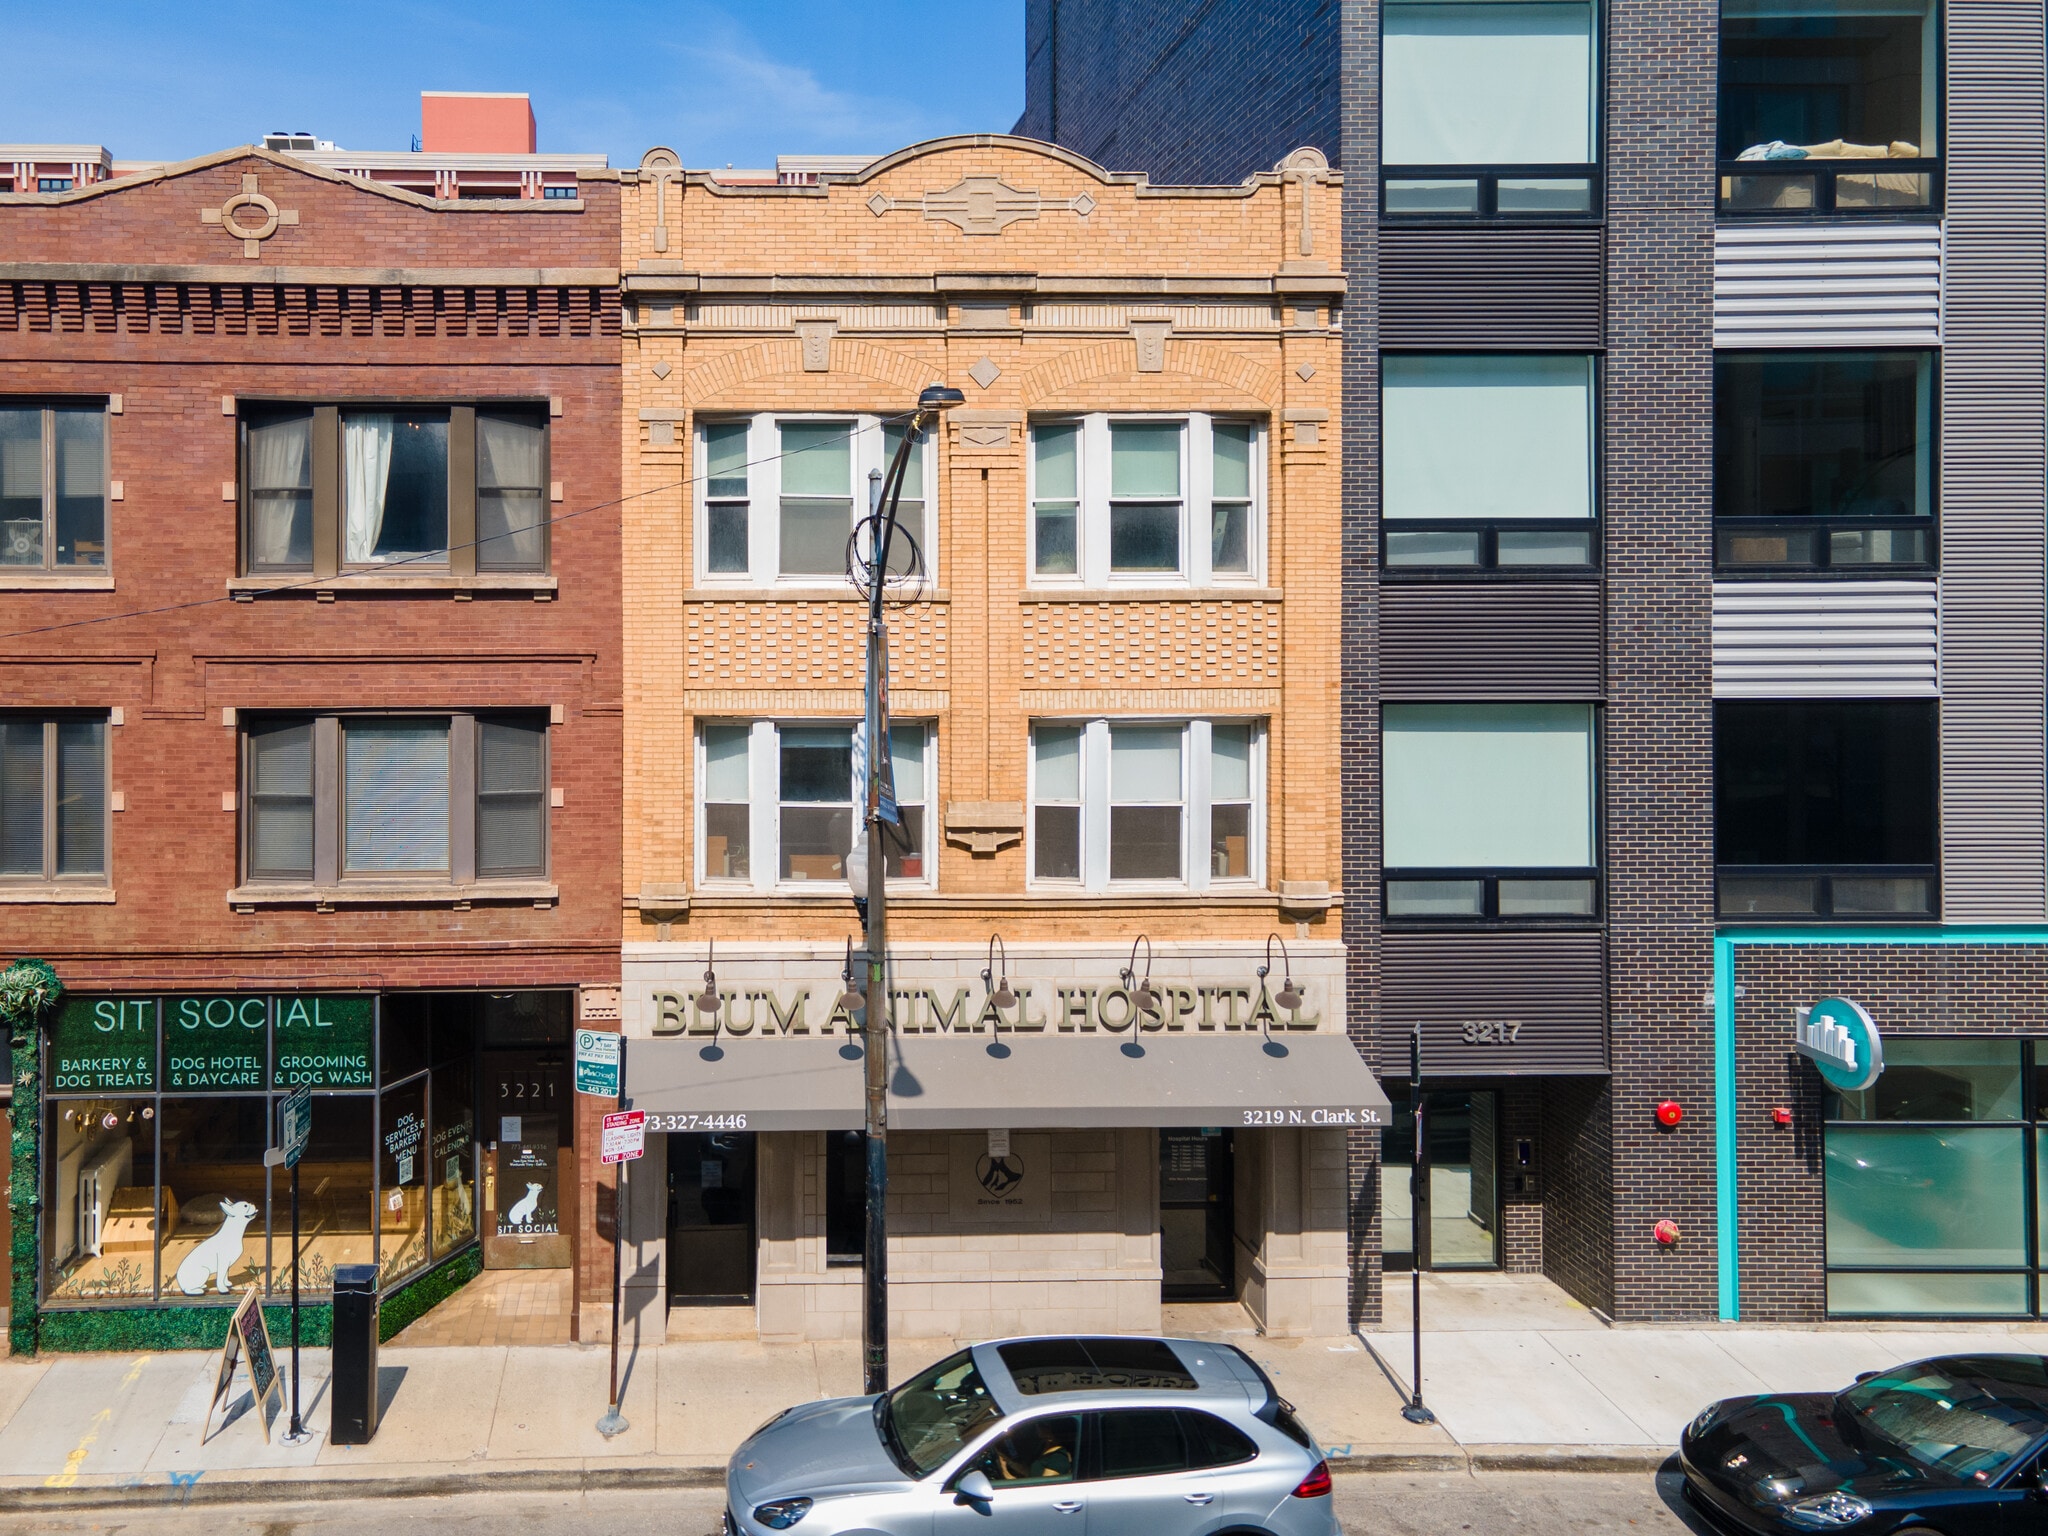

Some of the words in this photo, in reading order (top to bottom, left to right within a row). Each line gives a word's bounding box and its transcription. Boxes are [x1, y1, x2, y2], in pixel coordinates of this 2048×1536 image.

[94, 1001, 152, 1032] SIT
[179, 998, 333, 1029] SOCIAL
[652, 989, 810, 1036] BLUM
[1057, 985, 1322, 1033] HOSPITAL
[1462, 1021, 1522, 1044] 3217
[61, 1058, 132, 1072] BARKERY
[137, 1057, 147, 1070] &
[171, 1057, 205, 1069] DOG
[211, 1057, 261, 1069] HOTEL
[281, 1056, 366, 1068] GROOMING
[56, 1075, 90, 1087] DOG
[97, 1073, 152, 1086] TREATS
[173, 1074, 183, 1085] &
[189, 1072, 259, 1085] DAYCARE
[274, 1072, 283, 1084] &
[290, 1071, 323, 1084] DOG
[328, 1071, 372, 1083] WASH
[501, 1083, 554, 1098] 3221
[397, 1113, 414, 1128] DOG
[607, 1120, 627, 1128] STANDING
[645, 1114, 747, 1130] 73-327-4446
[1243, 1110, 1284, 1124] 3219
[1288, 1110, 1306, 1124] N.
[1311, 1109, 1356, 1123] Clark
[1361, 1109, 1381, 1123] St.
[385, 1122, 418, 1145] SERVICES
[420, 1119, 425, 1129] &
[432, 1131, 446, 1145] DOG
[448, 1119, 473, 1137] EVENTS
[389, 1131, 421, 1154] BARKERY
[396, 1145, 417, 1162] MENU
[622, 1151, 640, 1160] ZONE
[498, 1225, 514, 1234] SIT
[518, 1224, 558, 1233] SOCIAL
